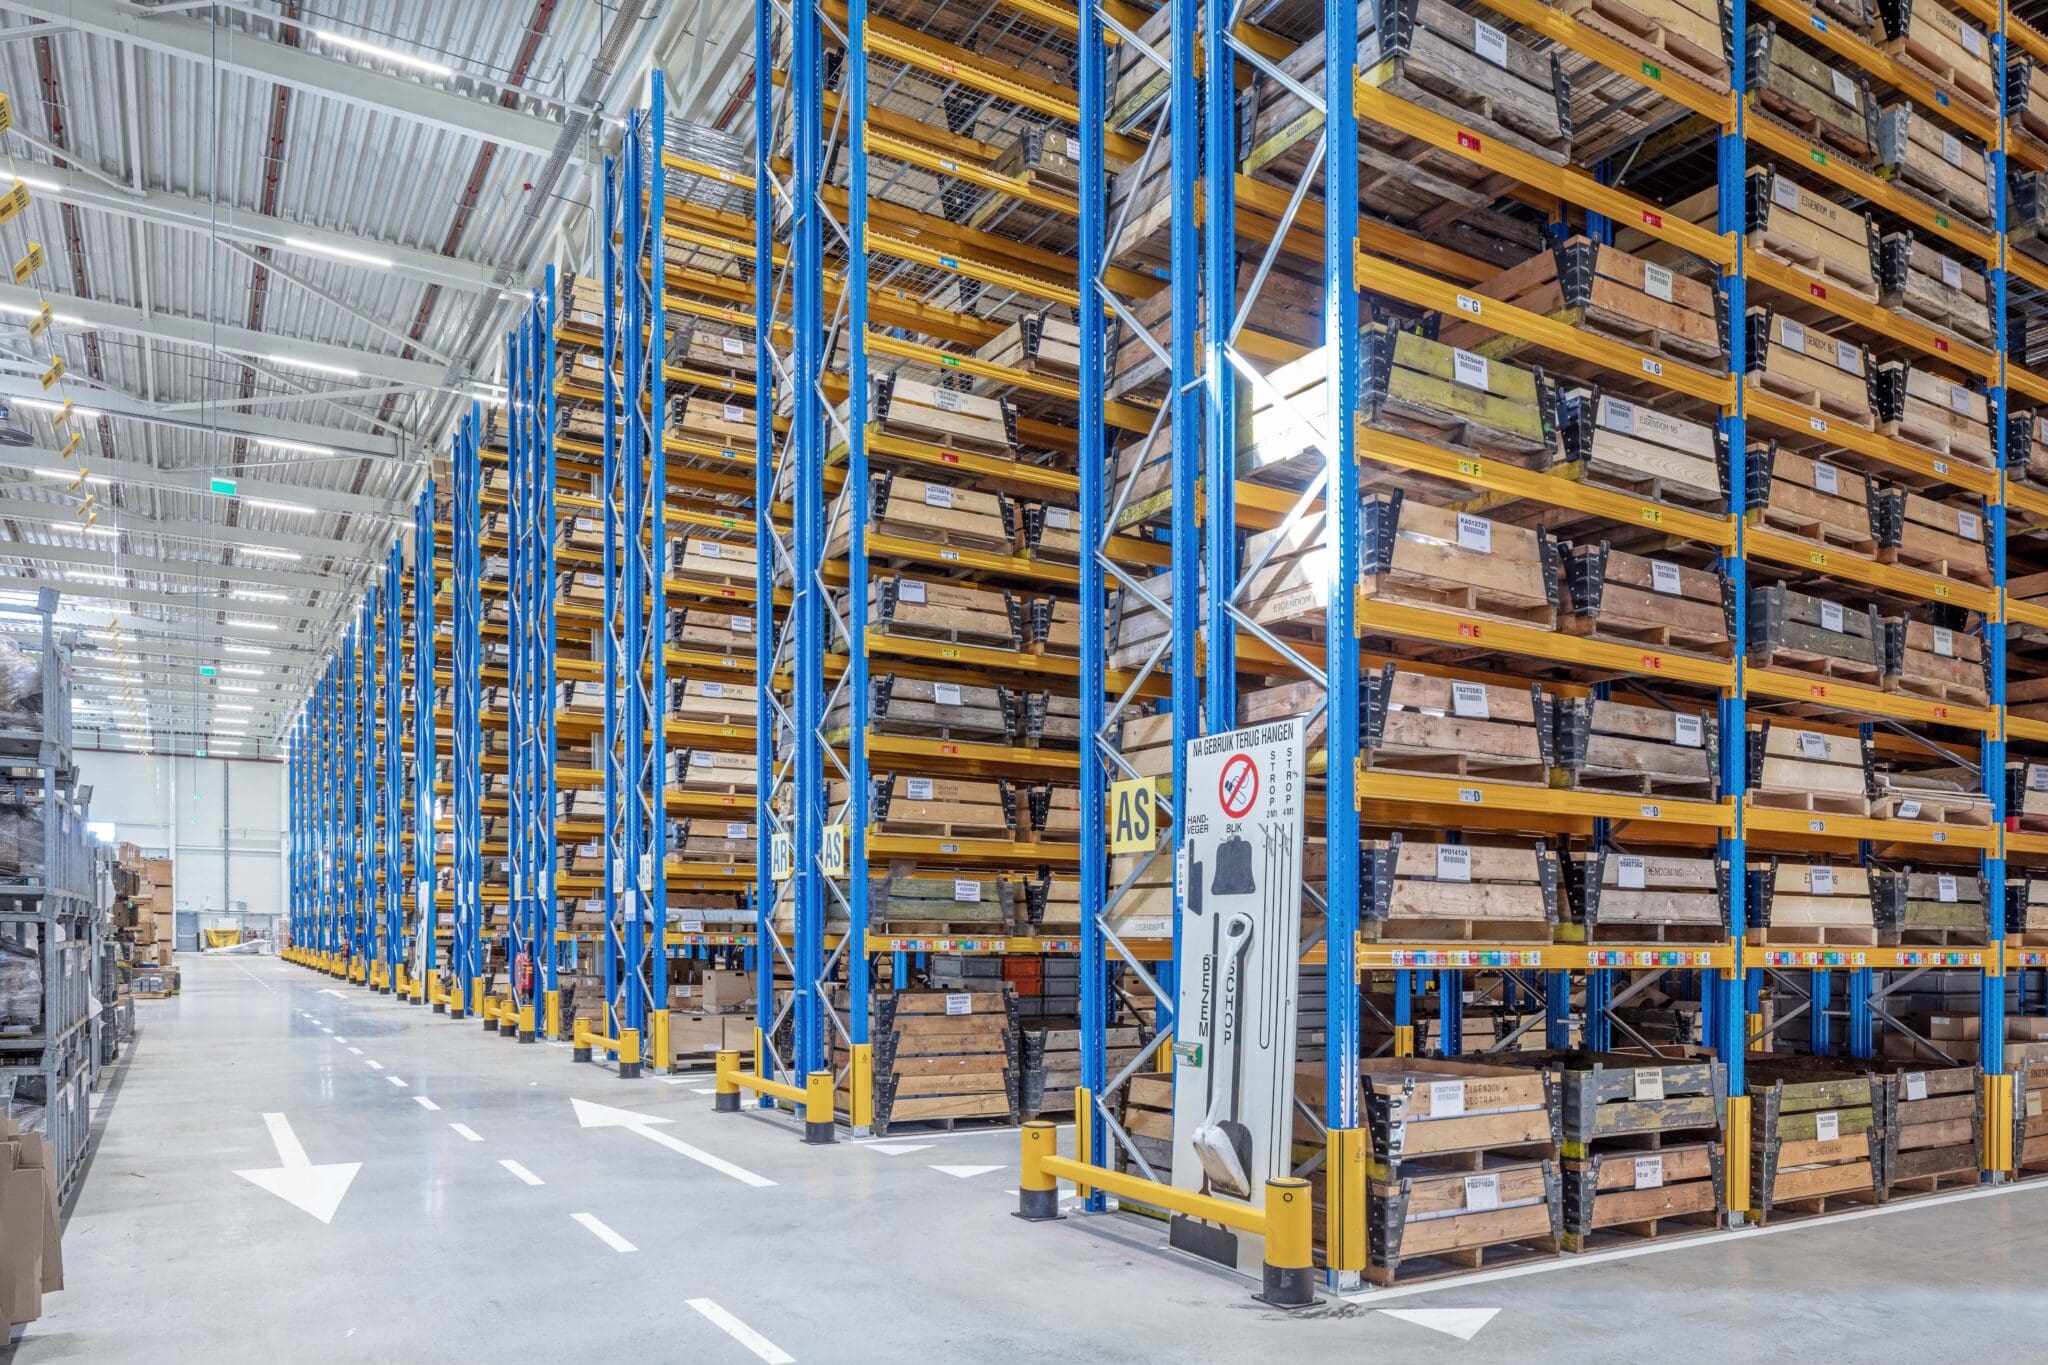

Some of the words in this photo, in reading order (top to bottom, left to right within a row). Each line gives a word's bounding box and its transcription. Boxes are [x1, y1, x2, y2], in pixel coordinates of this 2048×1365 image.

[1472, 300, 1479, 312] G
[1654, 363, 1660, 374] G
[1640, 416, 1669, 431] EIGENDOM
[1474, 464, 1479, 475] F
[1655, 511, 1659, 521] F
[1821, 555, 1824, 564] F
[1473, 625, 1479, 638] E
[1654, 657, 1659, 668] E
[1820, 687, 1824, 696] E
[1193, 741, 1203, 757] NA
[1204, 734, 1234, 756] GEBRUIK
[1236, 730, 1260, 750] TERUG
[1262, 722, 1294, 746] HANGEN
[1285, 747, 1293, 804] STROP
[1473, 790, 1480, 802] D
[1116, 788, 1150, 842] AS
[1653, 806, 1658, 817] D
[1187, 814, 1209, 825] HAND-
[1187, 824, 1209, 834] VEGER
[1226, 822, 1242, 832] BLIK
[1819, 821, 1824, 831] D
[825, 832, 841, 868] AS
[773, 840, 788, 872] AR
[1198, 956, 1210, 1038] BEZEM
